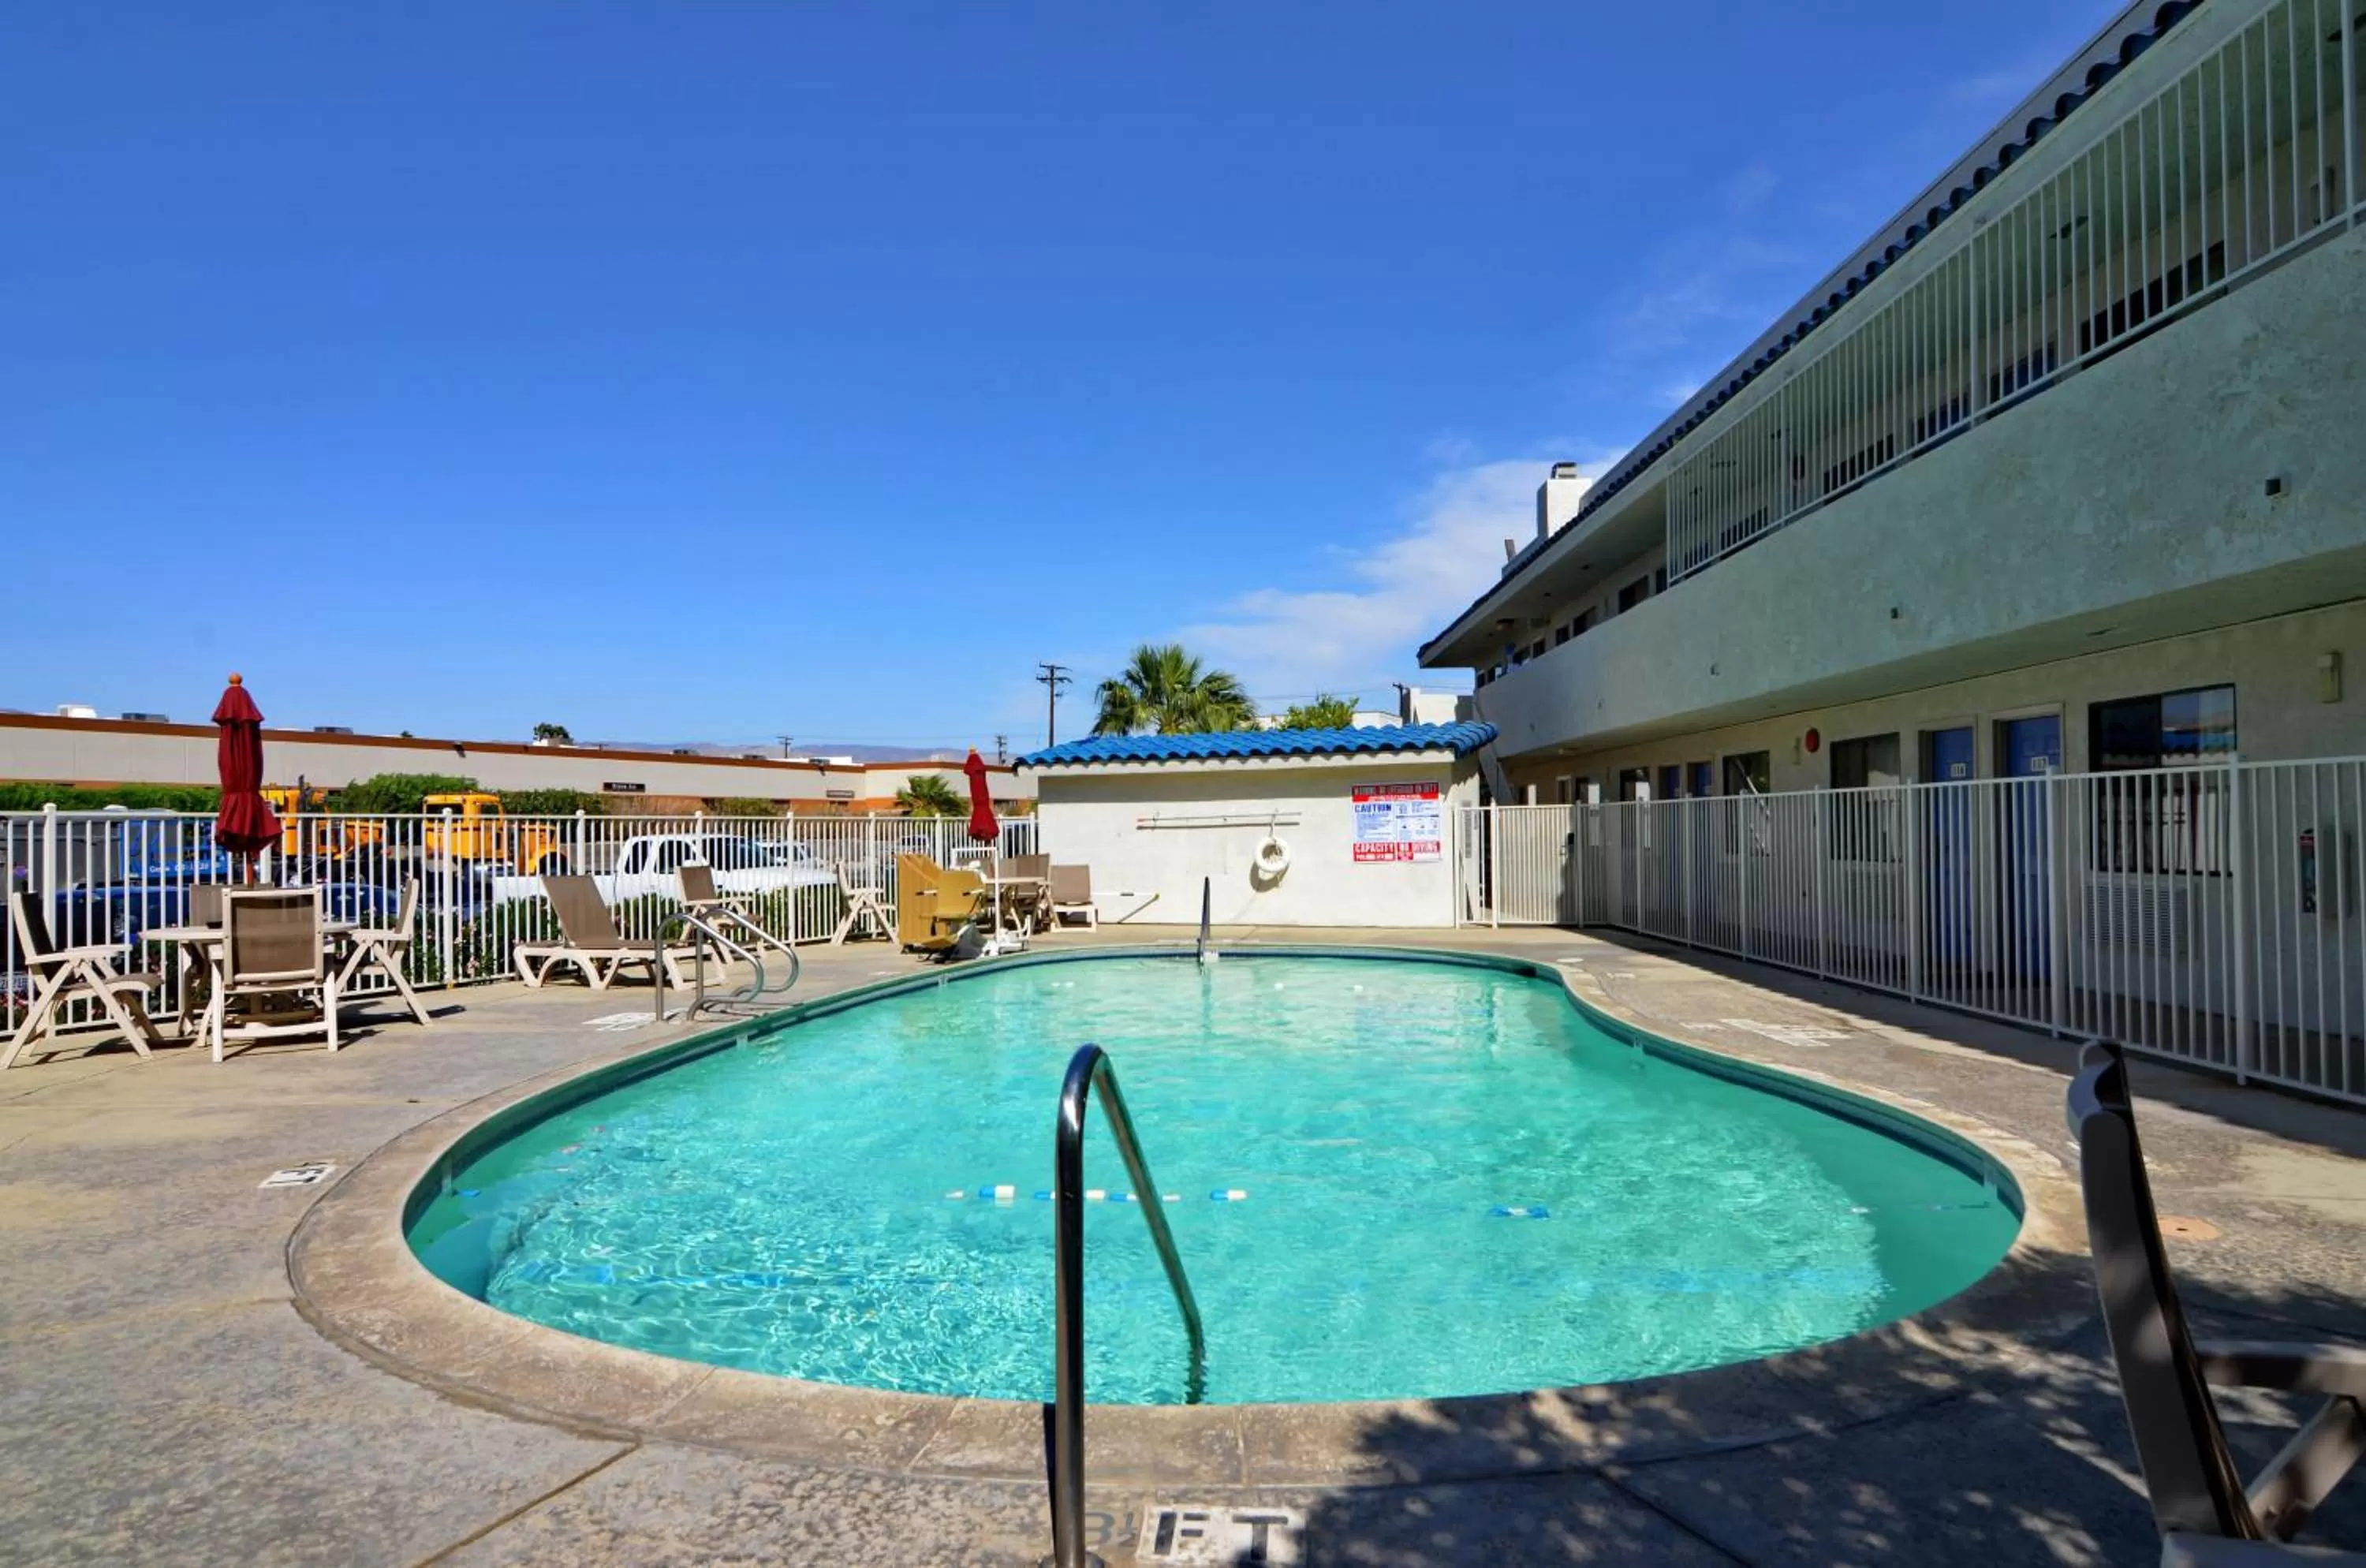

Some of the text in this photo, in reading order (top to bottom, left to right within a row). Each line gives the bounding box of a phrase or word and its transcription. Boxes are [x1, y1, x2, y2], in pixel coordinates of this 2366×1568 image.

[1354, 803, 1392, 812] CAUTION
[1355, 842, 1394, 852] CAPACITY
[1154, 1511, 1289, 1561] FT
